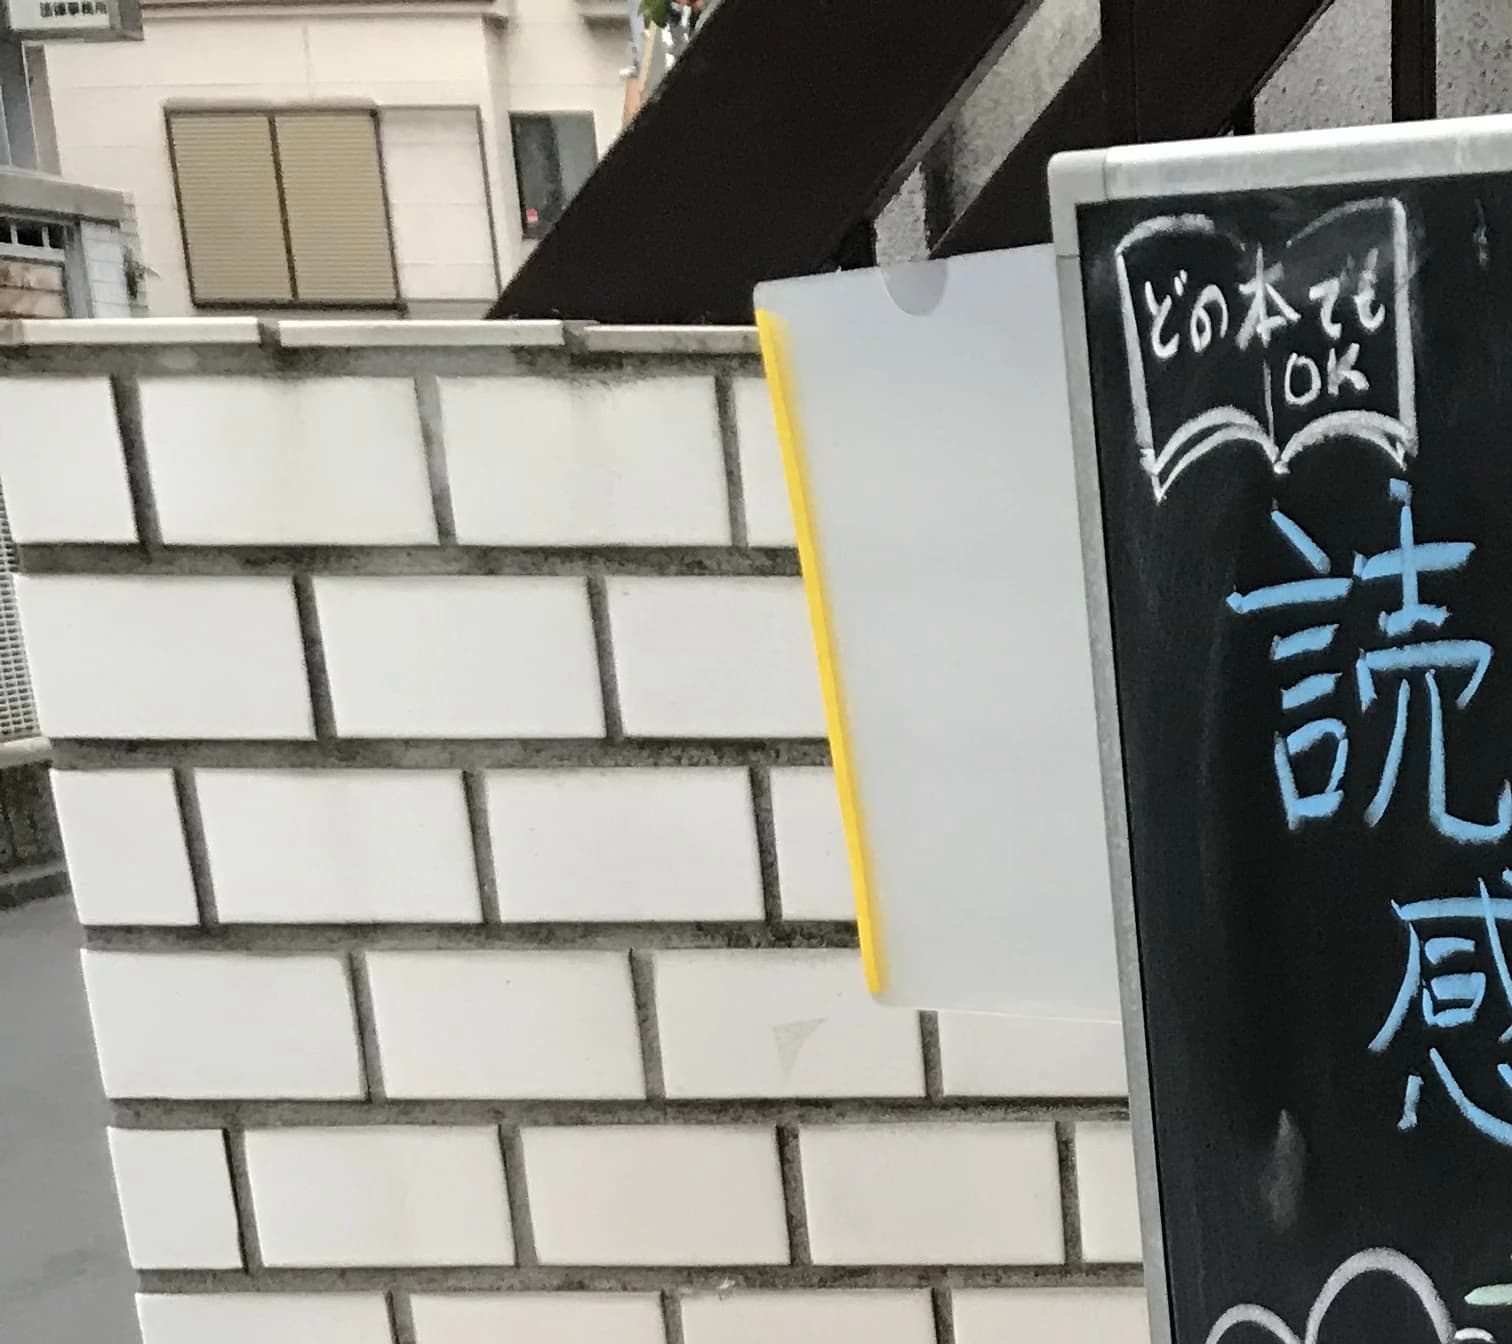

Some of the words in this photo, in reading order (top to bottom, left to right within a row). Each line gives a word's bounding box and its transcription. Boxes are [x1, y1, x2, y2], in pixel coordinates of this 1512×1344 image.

[1143, 249, 1387, 358] どの本でも
[1284, 350, 1370, 405] OK
